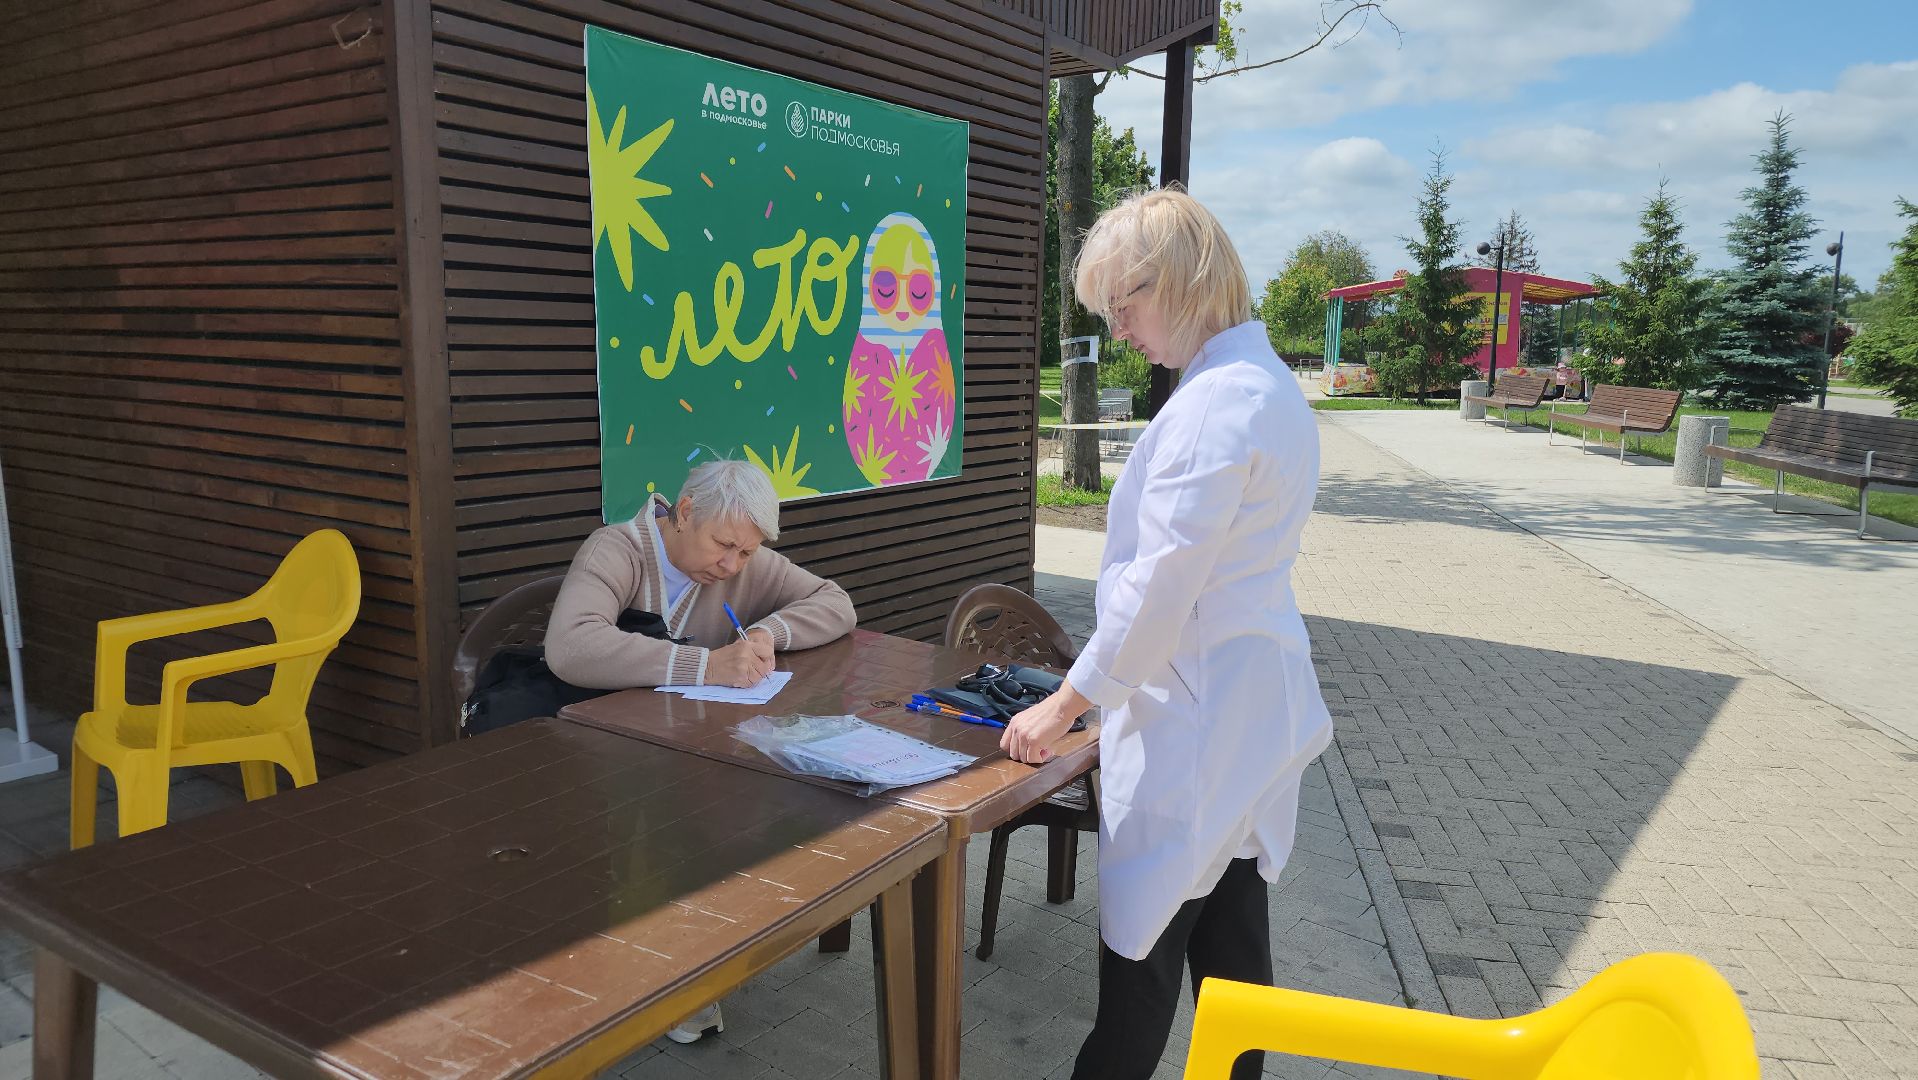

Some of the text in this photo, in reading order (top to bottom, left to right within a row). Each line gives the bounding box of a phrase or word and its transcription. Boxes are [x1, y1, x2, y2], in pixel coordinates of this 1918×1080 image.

[709, 110, 767, 130] подмосковье
[810, 106, 851, 129] ПАРКИ
[810, 125, 900, 157] ПОДМОСКОВЬЯ
[640, 228, 860, 379] лето
